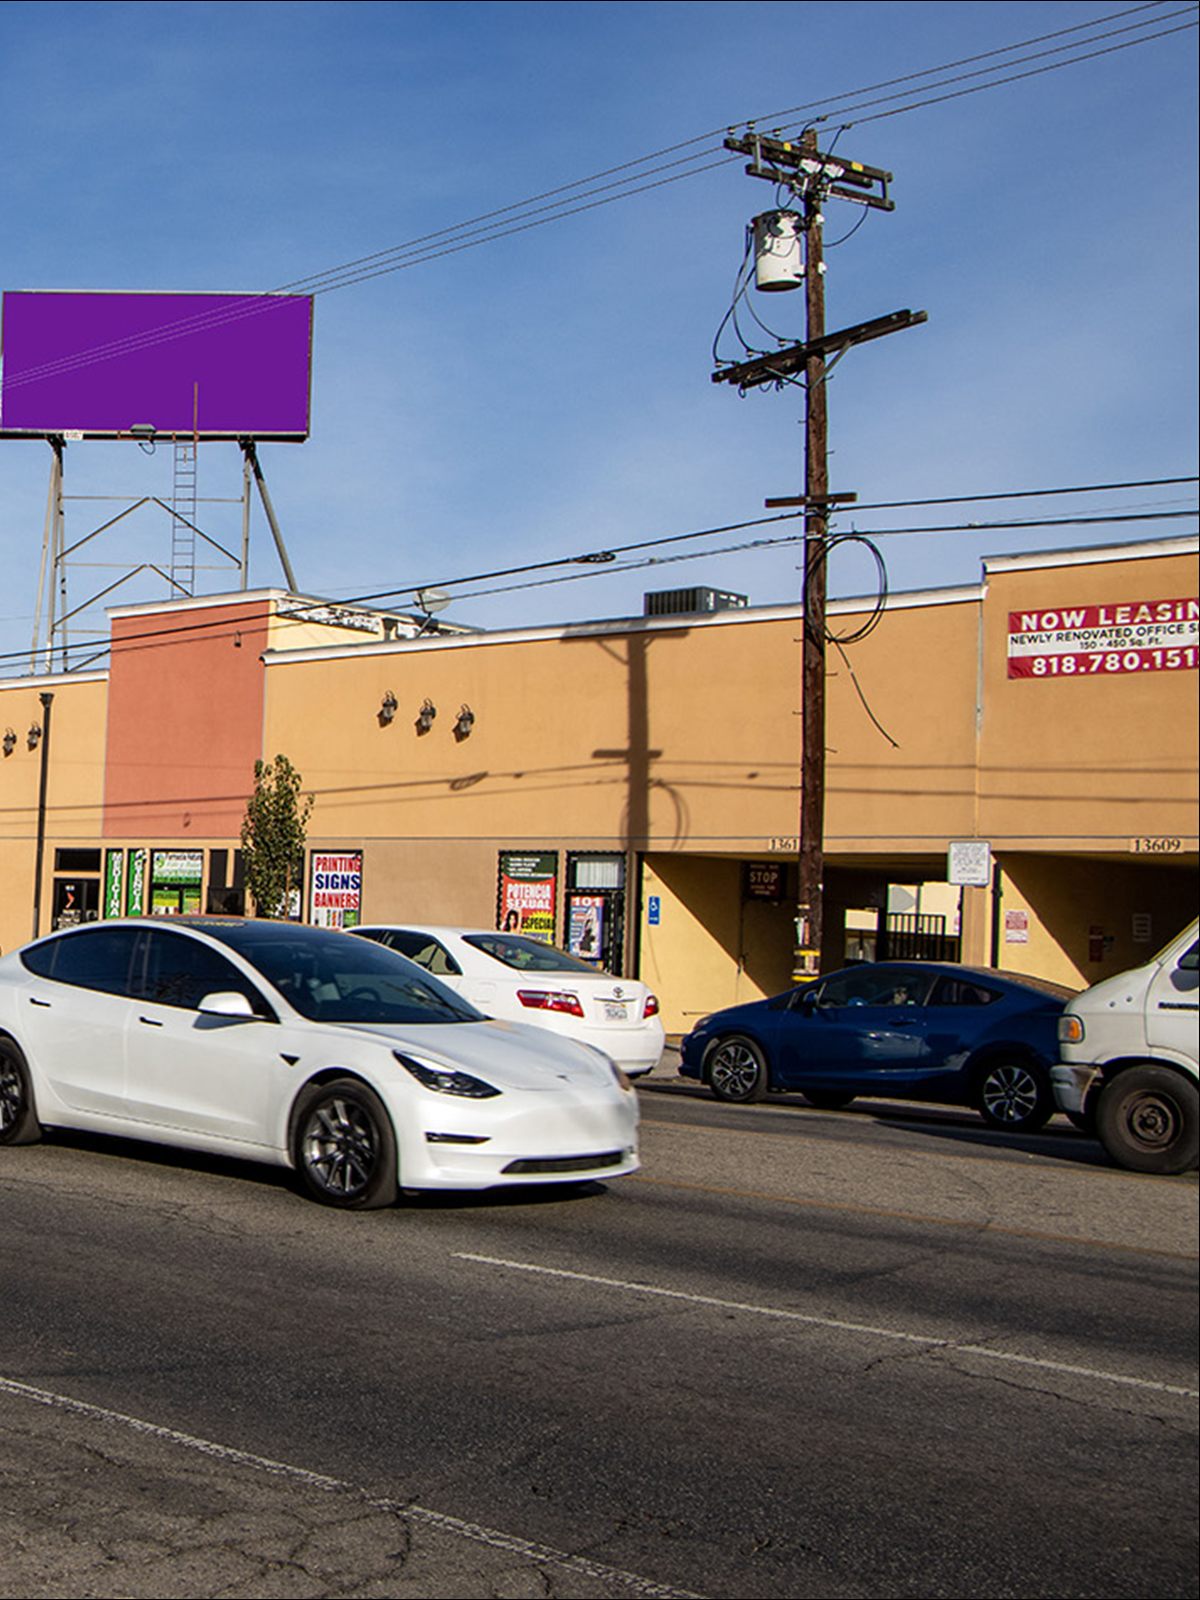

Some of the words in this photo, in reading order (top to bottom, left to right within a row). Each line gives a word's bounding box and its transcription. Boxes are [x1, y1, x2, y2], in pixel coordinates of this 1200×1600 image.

[1021, 610, 1086, 631] NOW
[1010, 633, 1053, 645] NEWLY
[1056, 627, 1132, 641] RENOVATED
[1136, 624, 1184, 636] OFFICE
[1188, 622, 1199, 634] S
[1079, 640, 1097, 650] 150
[1106, 639, 1127, 648] 450
[1032, 648, 1199, 676] 818.780.151
[771, 839, 798, 850] 1361
[1134, 839, 1181, 851] 13609
[315, 856, 361, 872] PRINTING
[110, 852, 123, 916] MEDICINA
[315, 873, 361, 890] SIGNS
[749, 871, 778, 883] STOP
[506, 883, 551, 899] POTENCIA
[314, 892, 359, 909] BANNERS
[506, 899, 551, 910] SEXUAL
[572, 897, 602, 906] 101
